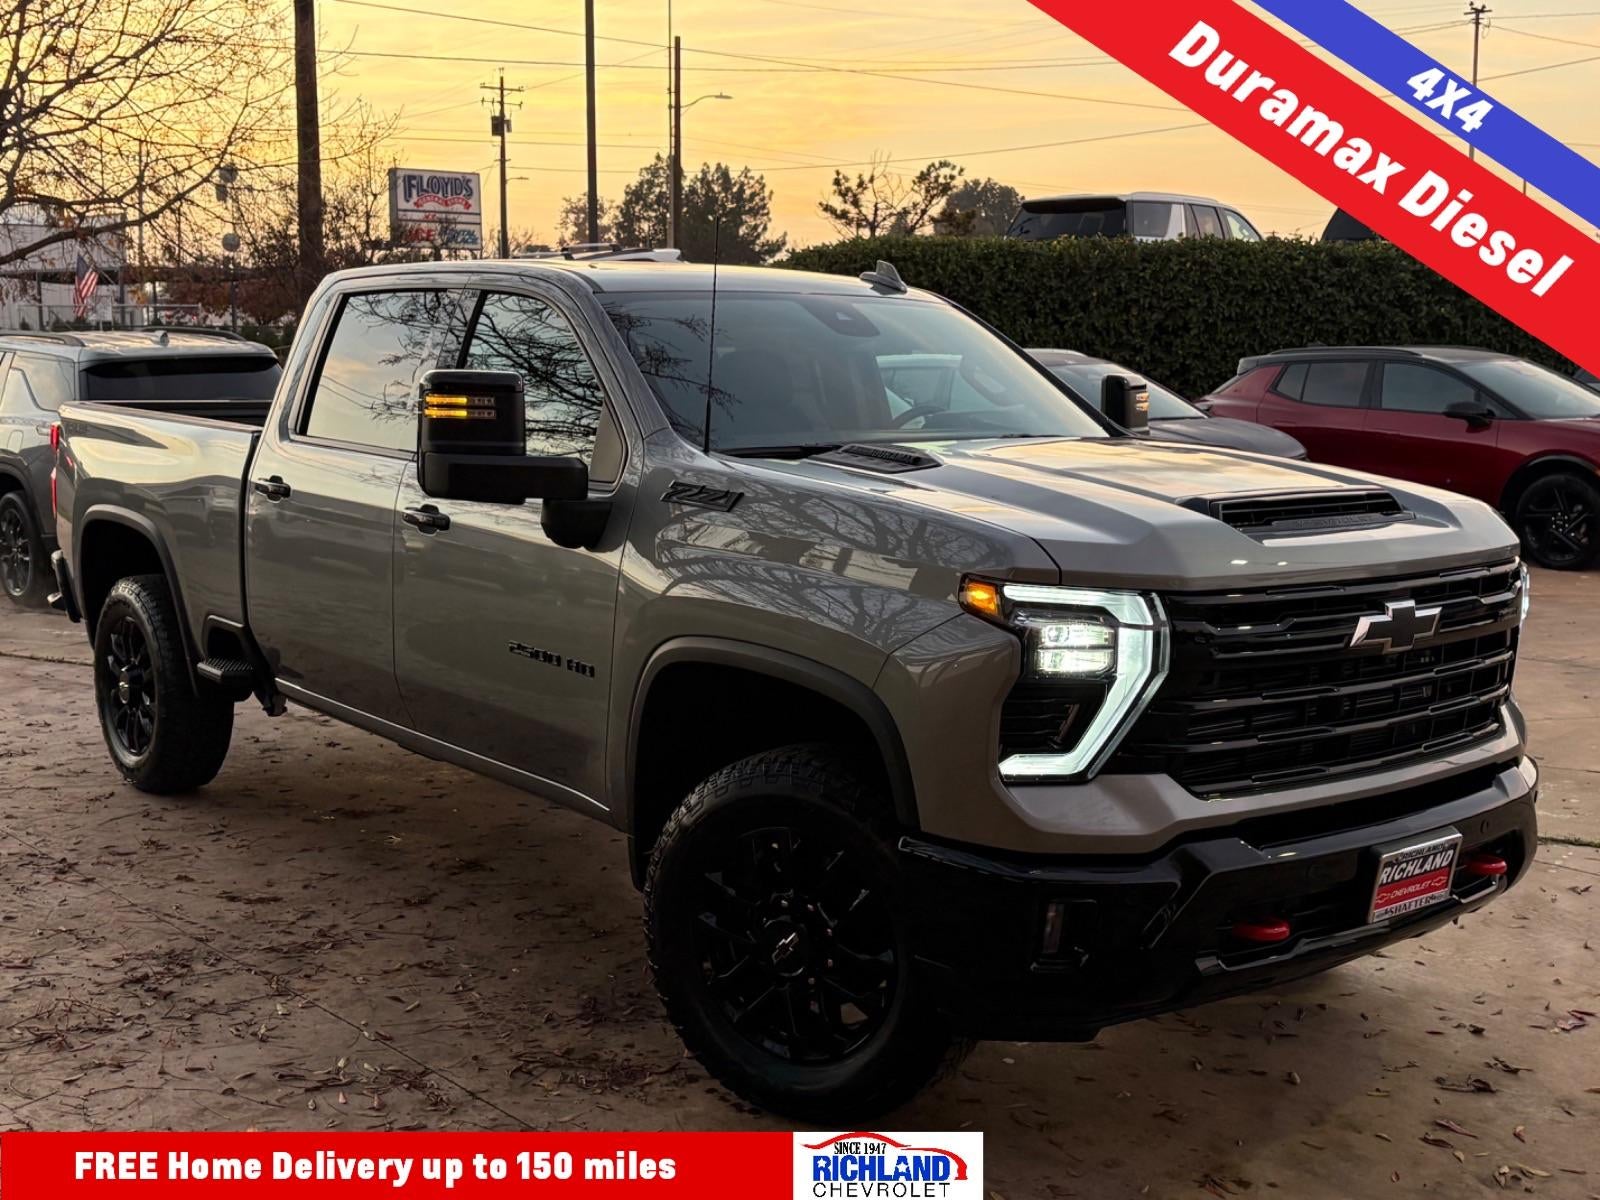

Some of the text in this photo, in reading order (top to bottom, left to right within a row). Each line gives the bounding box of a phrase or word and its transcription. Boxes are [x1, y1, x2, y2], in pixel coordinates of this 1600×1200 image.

[403, 174, 474, 203] FLOYD'S
[508, 639, 562, 668] 2500
[1379, 849, 1455, 885] RICHLAND
[1390, 880, 1432, 899] CHEVROLET
